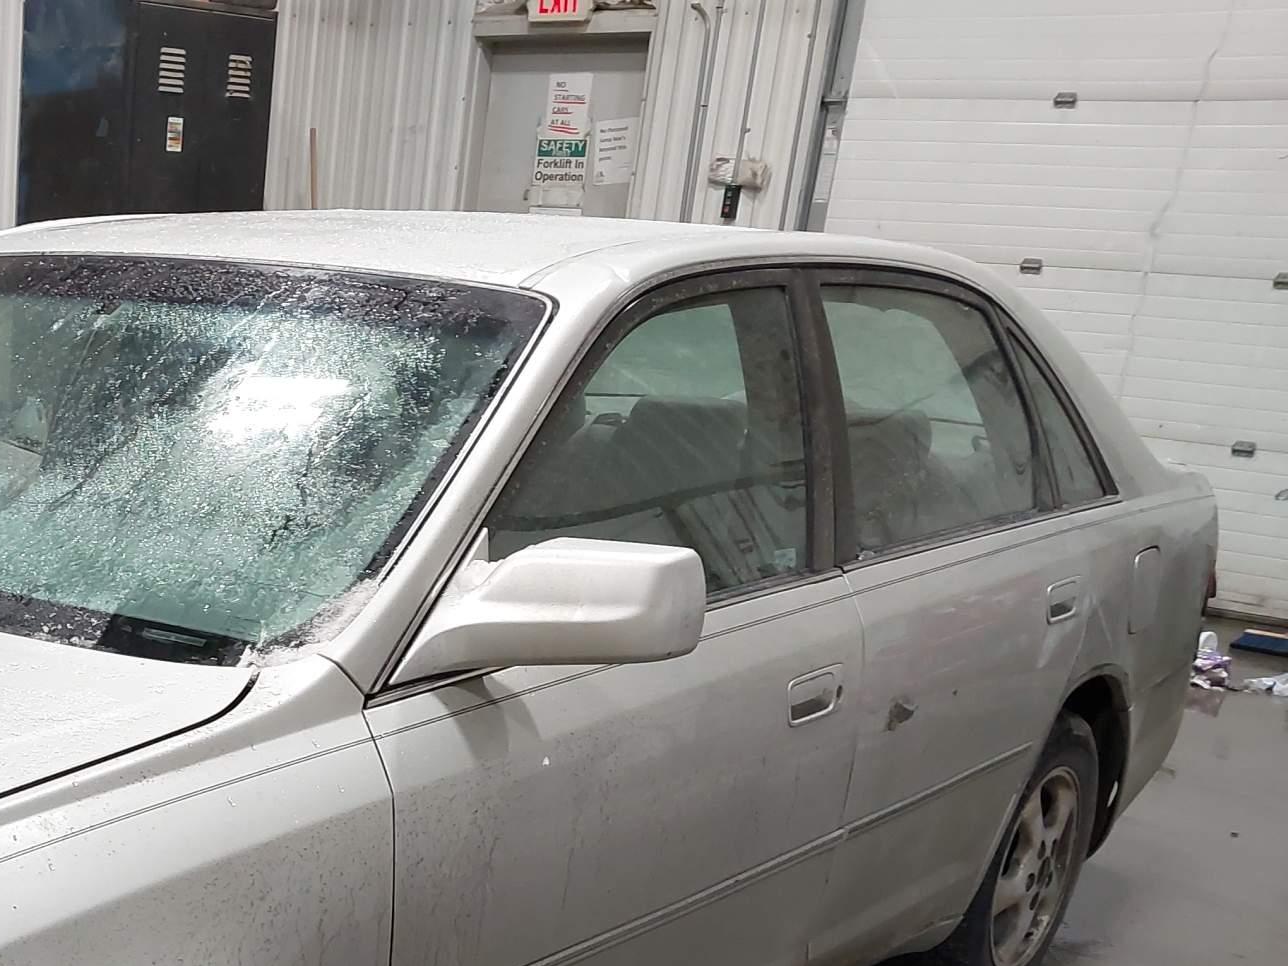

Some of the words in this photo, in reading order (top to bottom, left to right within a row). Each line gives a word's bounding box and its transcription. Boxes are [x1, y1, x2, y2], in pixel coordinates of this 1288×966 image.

[540, 140, 585, 152] SAFETY
[537, 159, 572, 169] Forklift
[575, 159, 584, 169] In
[535, 171, 584, 183] Operation
